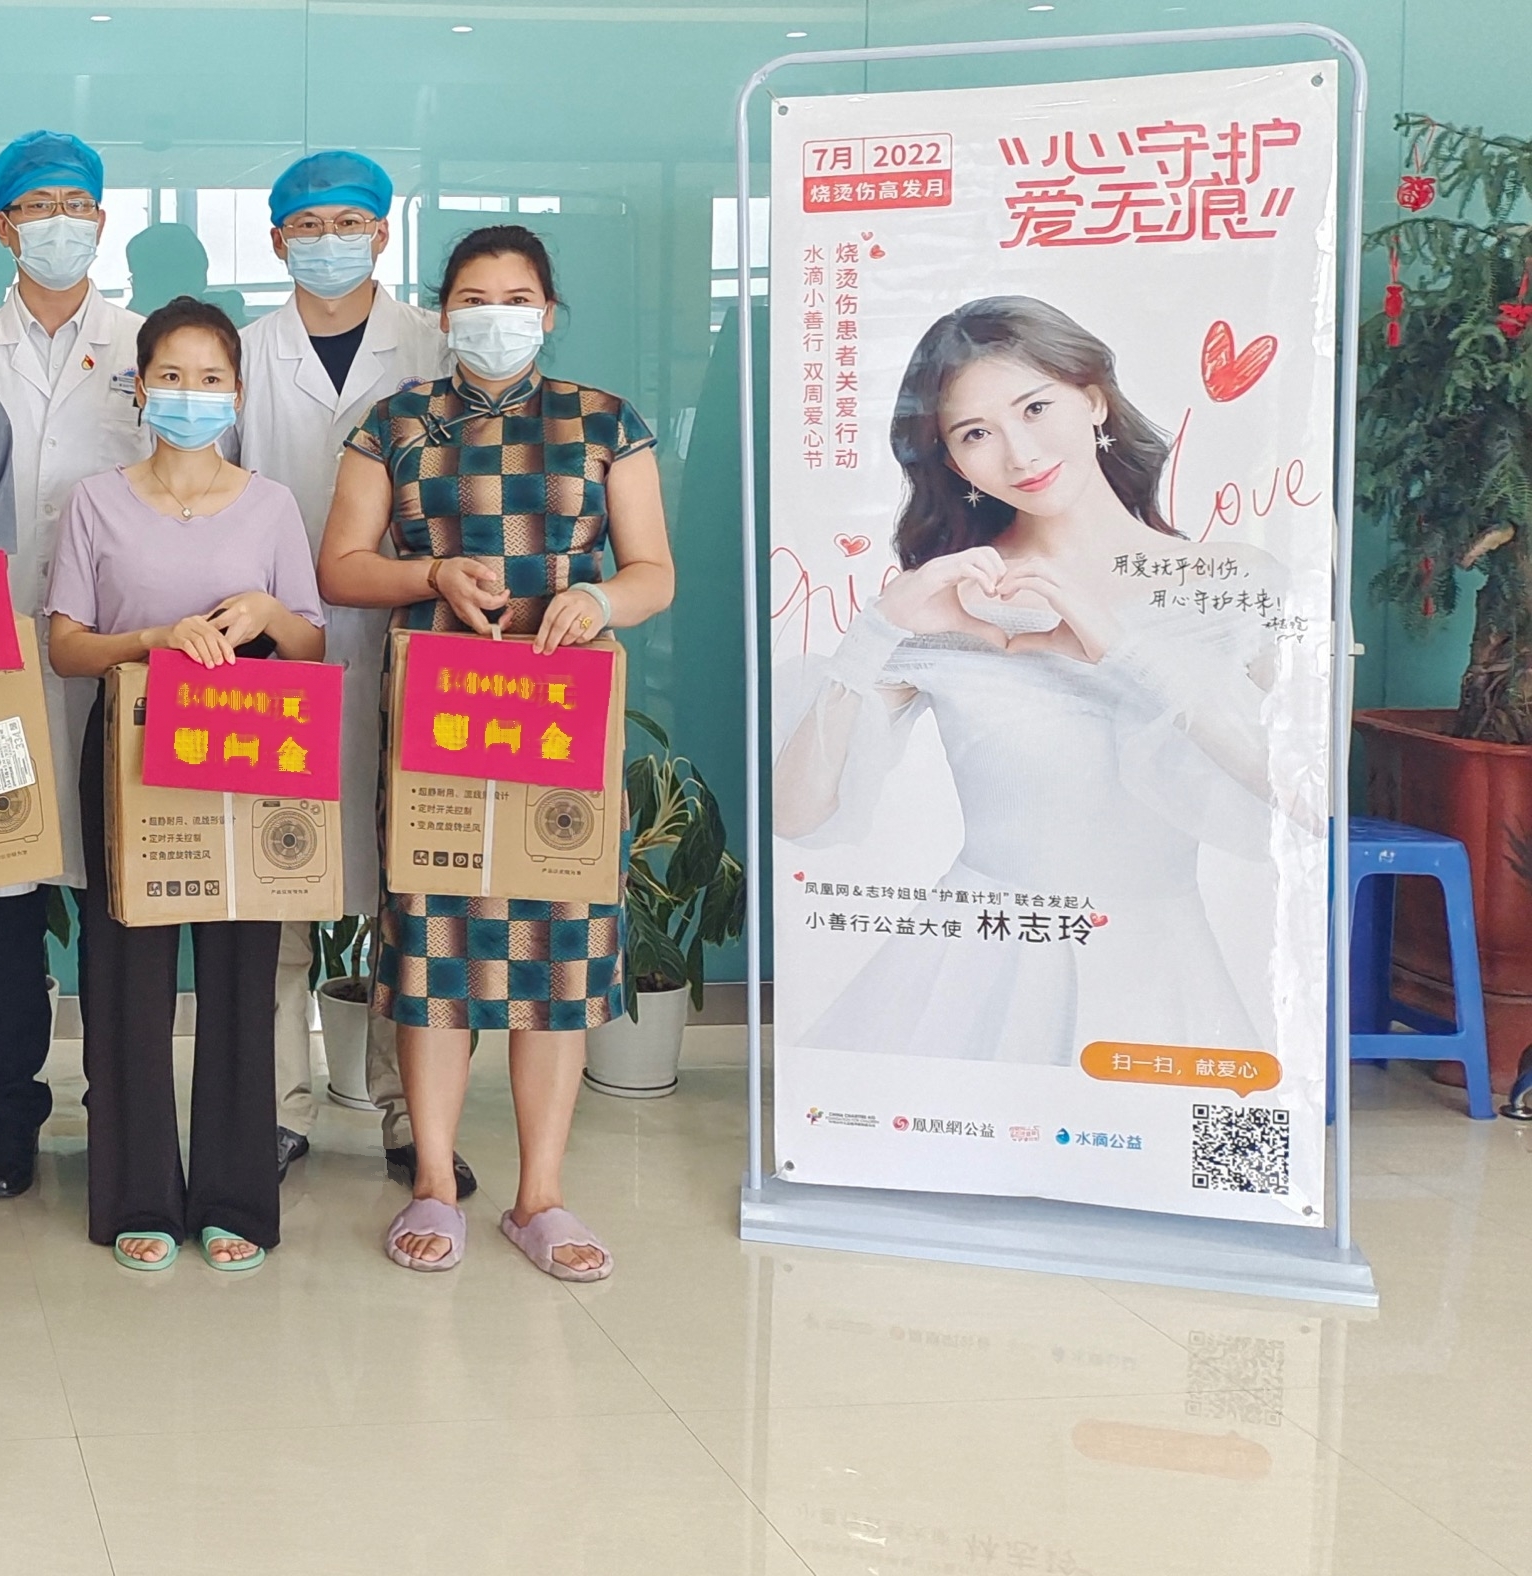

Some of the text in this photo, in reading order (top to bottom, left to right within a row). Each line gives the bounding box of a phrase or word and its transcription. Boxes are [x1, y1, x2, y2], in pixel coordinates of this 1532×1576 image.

[812, 142, 942, 171] 7月 2022
[810, 178, 944, 203] 烧烫伤高发月
[803, 244, 824, 470] 水滴小善行 双周爱心节
[835, 243, 859, 469] 烧烫伤患者关爱行动
[1014, 892, 1096, 911] 联合发起人
[805, 909, 1094, 945] 小善行公益大使 林志玲
[911, 1117, 996, 1139] 鳳凰網公益
[1074, 1130, 1143, 1150] 水滴公益
